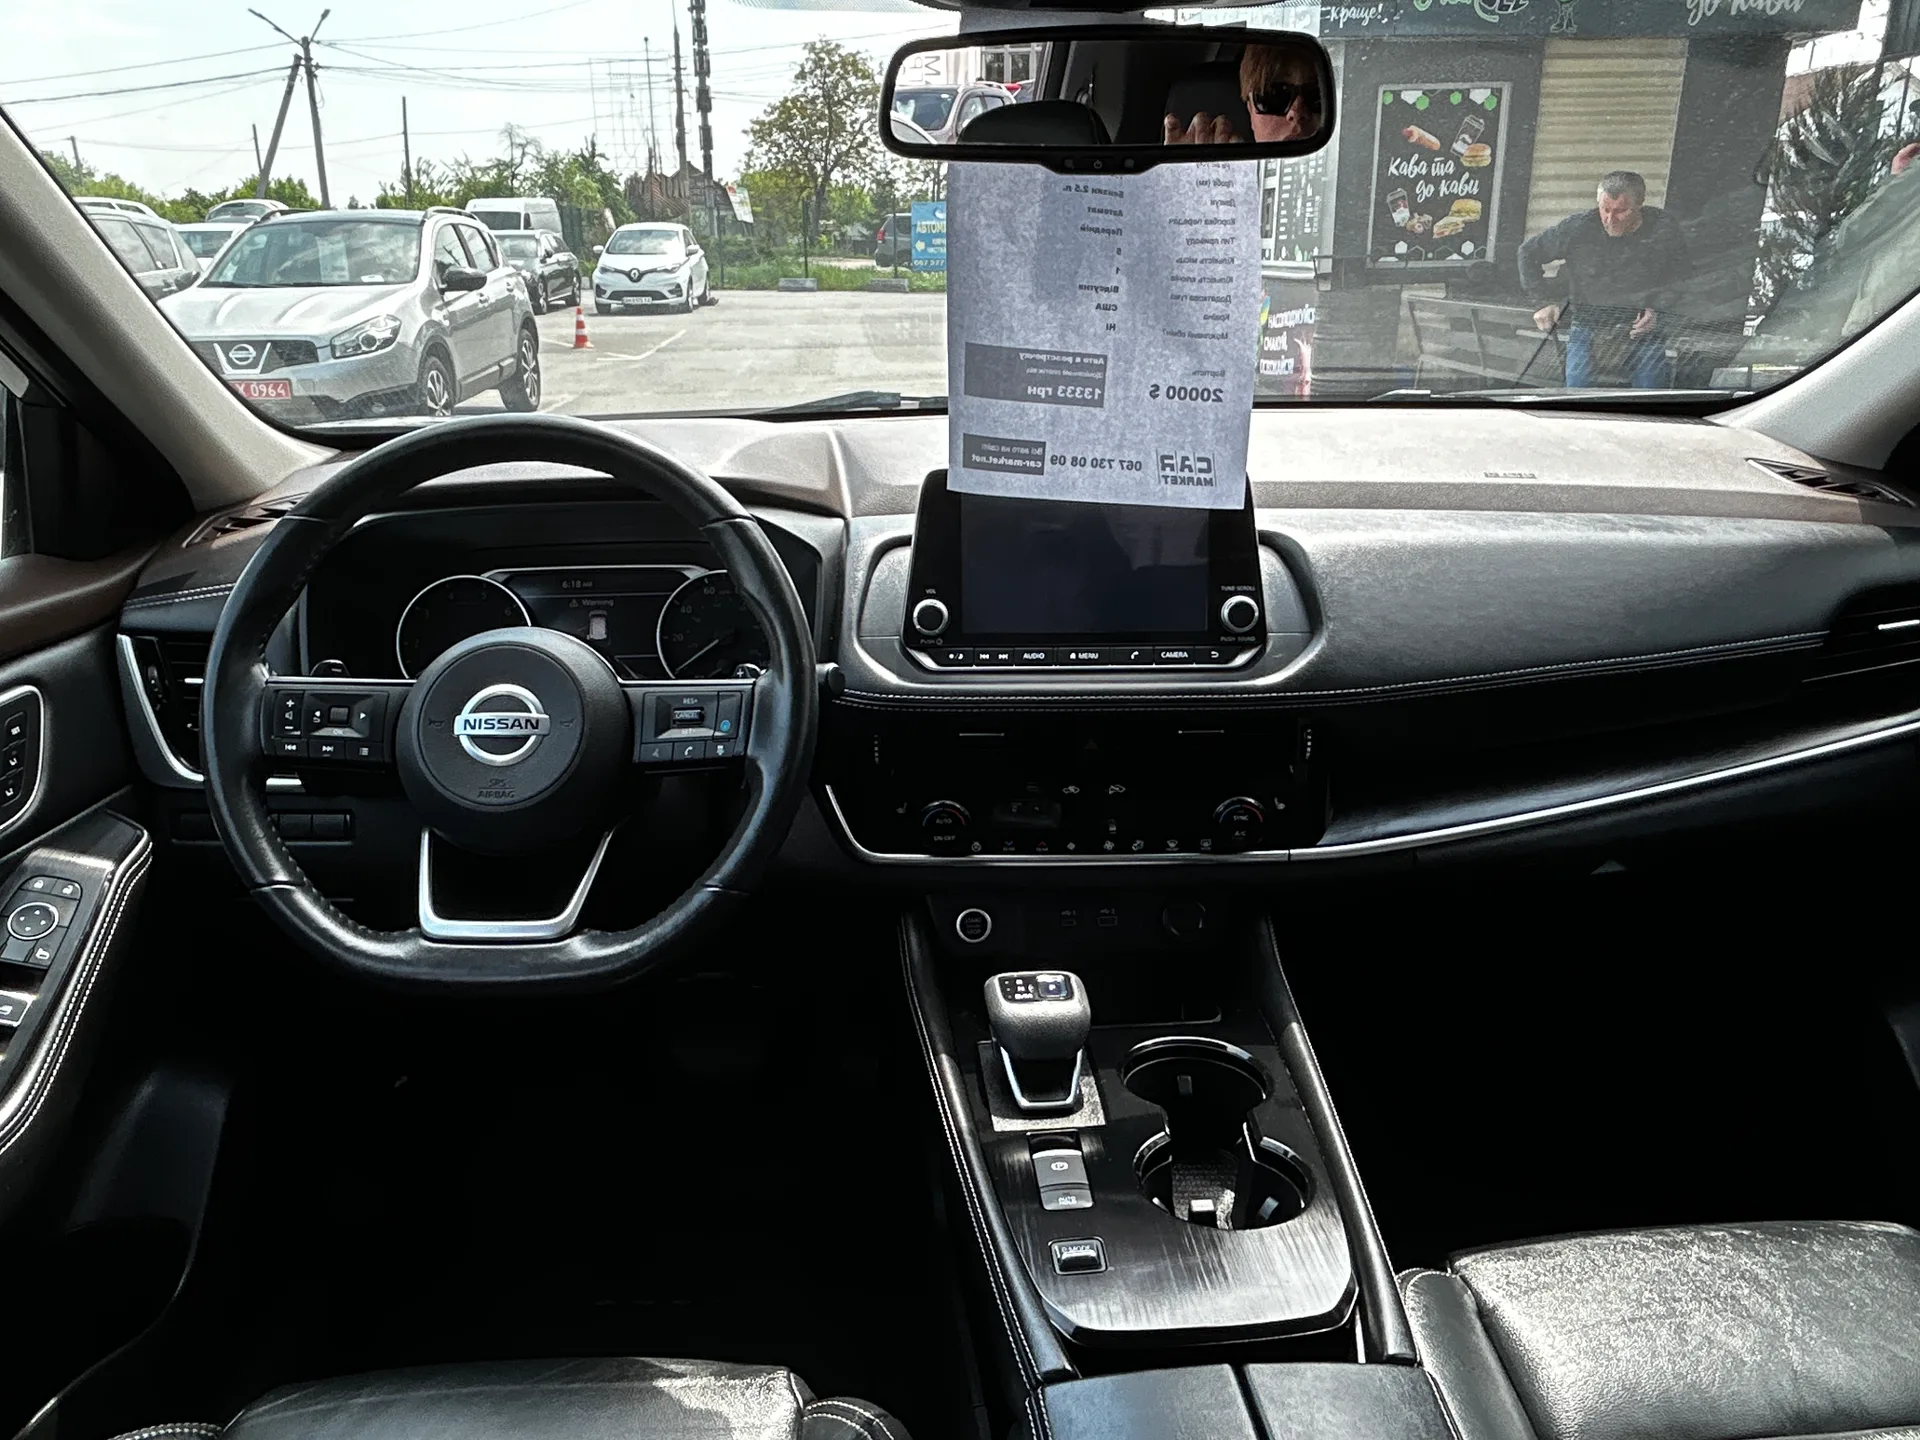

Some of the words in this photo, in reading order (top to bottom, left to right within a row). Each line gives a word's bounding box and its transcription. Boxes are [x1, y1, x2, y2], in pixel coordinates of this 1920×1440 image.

[1330, 3, 1384, 29] краще!
[1388, 153, 1428, 178] Кава
[1415, 180, 1435, 203] до
[1439, 171, 1480, 197] кави
[250, 383, 286, 397] 0964
[561, 580, 581, 589] 6:18
[581, 599, 615, 608] Warning
[1022, 650, 1046, 660] AUDIO
[1077, 651, 1100, 661] MENU
[1160, 650, 1189, 660] CAMERA
[463, 718, 540, 731] NISSAN
[477, 790, 516, 800] AIRBAG
